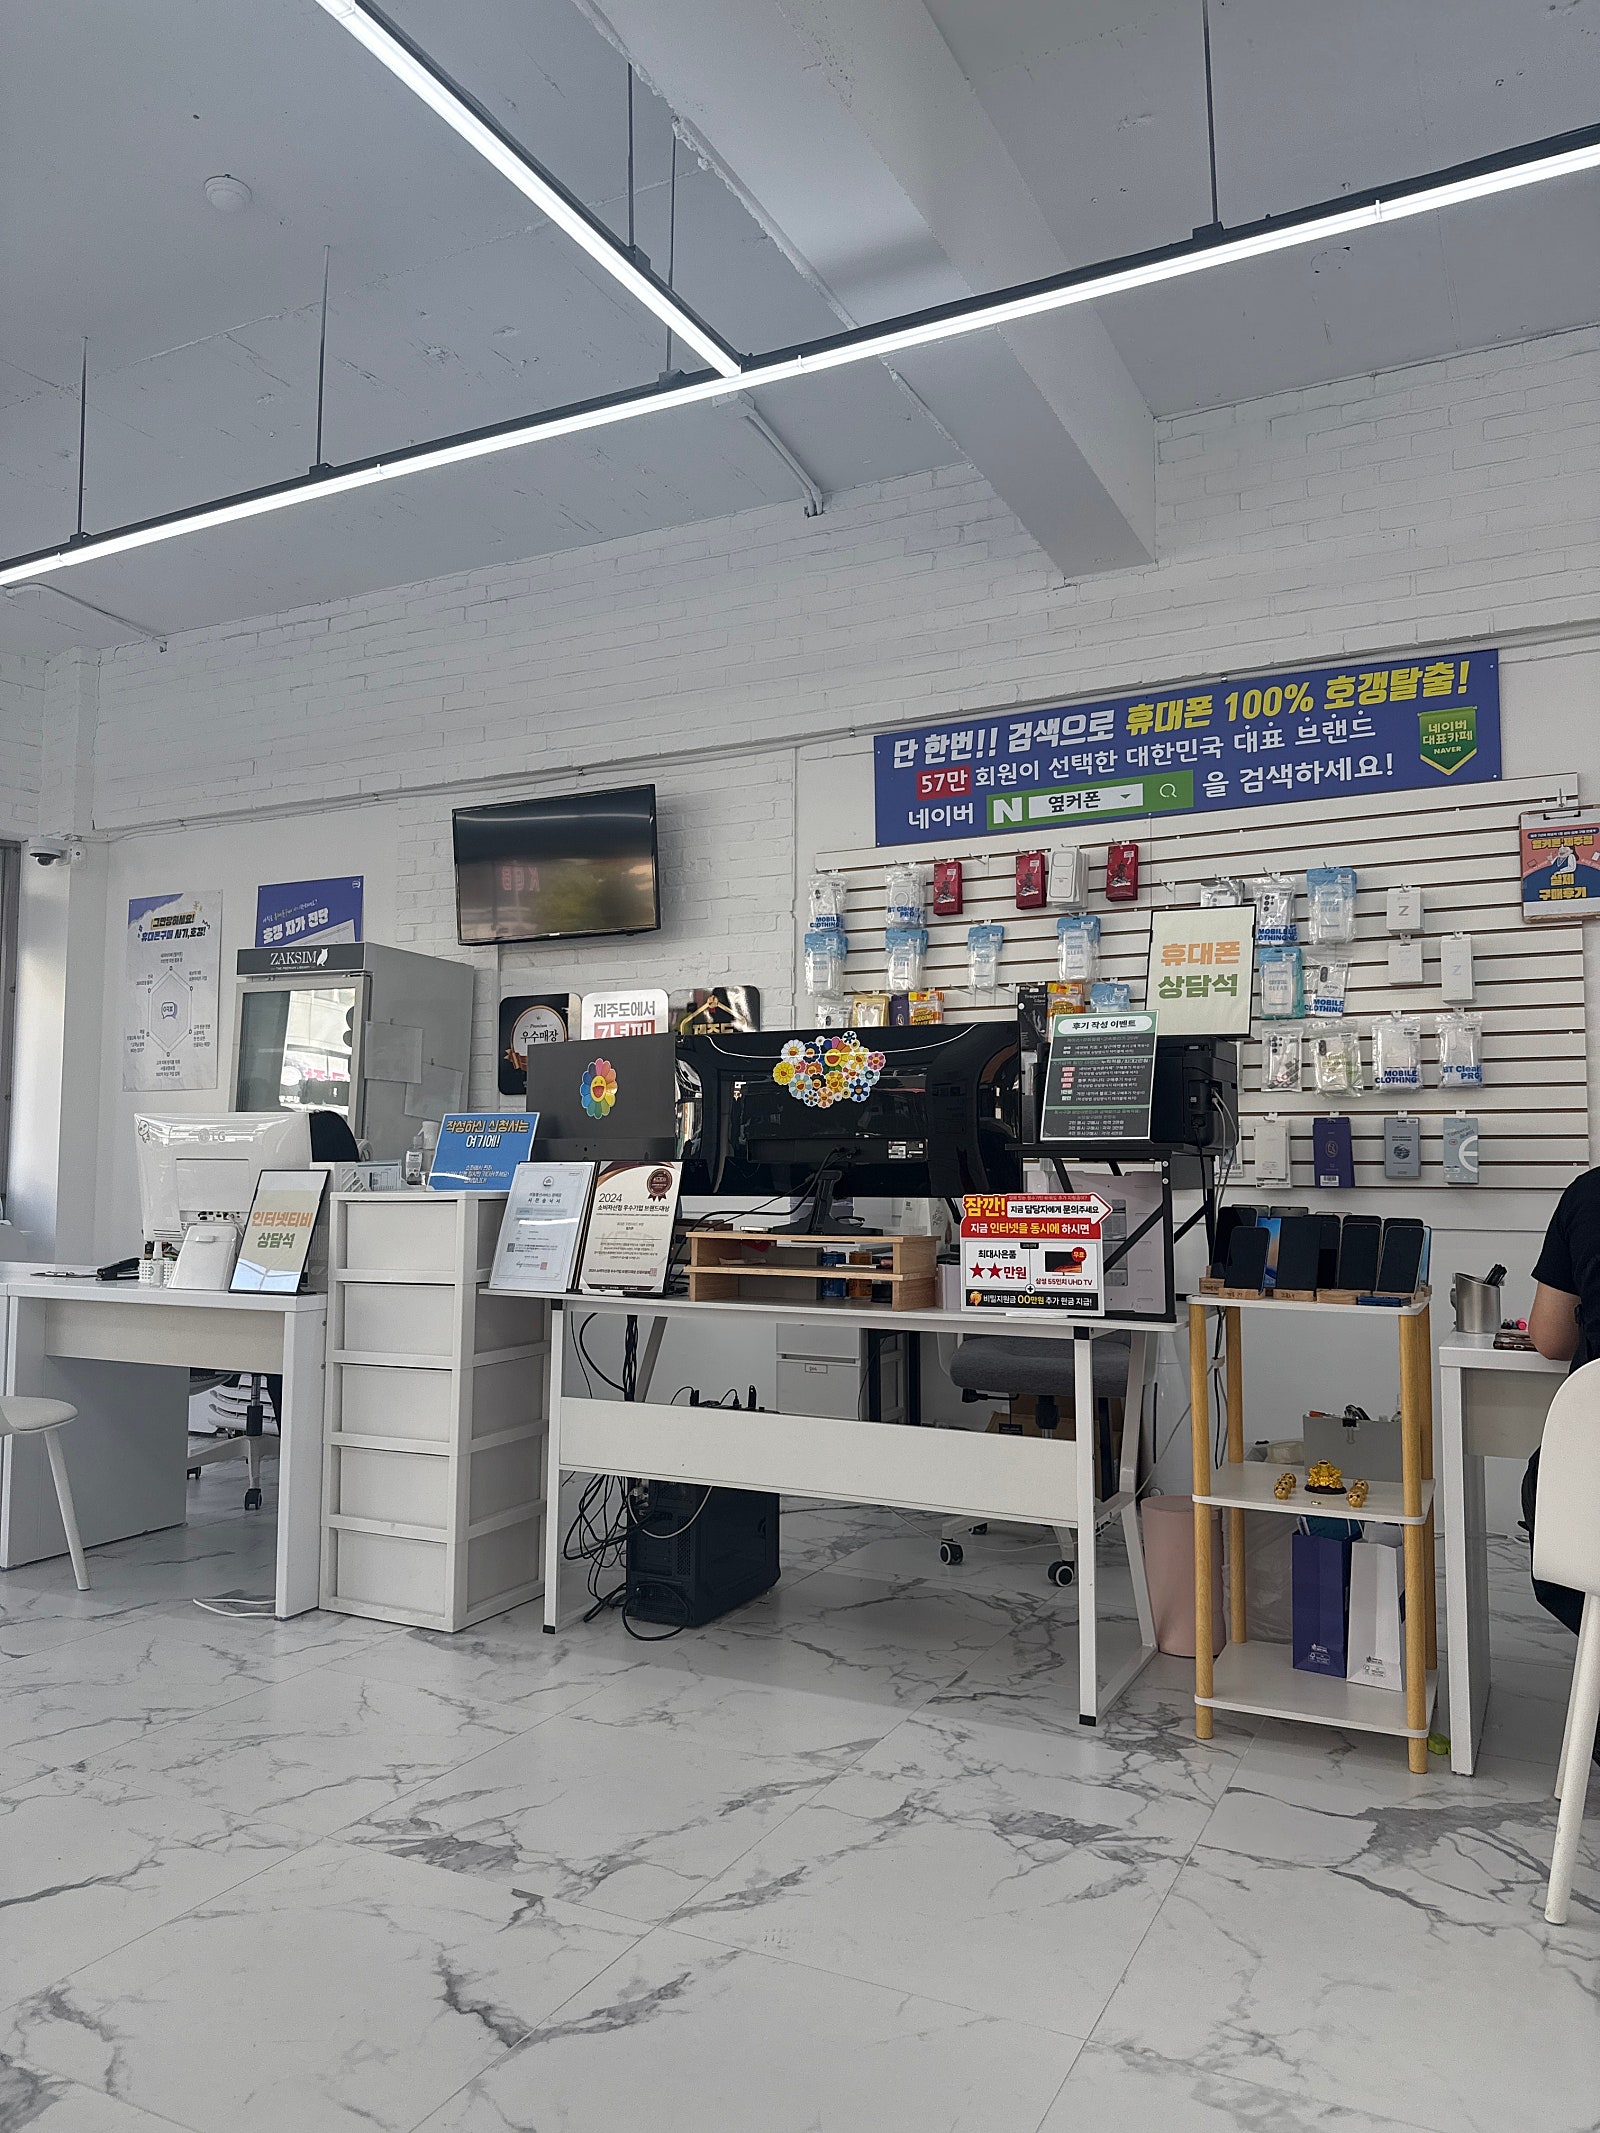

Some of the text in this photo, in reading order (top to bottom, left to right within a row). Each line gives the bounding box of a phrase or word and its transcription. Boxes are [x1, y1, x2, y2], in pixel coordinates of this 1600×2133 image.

[893, 660, 1470, 769] 단 한번!! 검색으로 휴대폰 100% 호갱탈출!
[1428, 719, 1467, 733] 네이버
[1422, 731, 1473, 745] 대표카페
[921, 714, 1376, 794] 57만 회원이 선택한 대한민국 대표 브랜드
[1433, 746, 1462, 755] NAVER
[908, 753, 1394, 830] 네이버 N 옆커폰 을 검색하세요!
[1539, 886, 1587, 900] 구매후기
[285, 916, 306, 936] 자가
[308, 907, 329, 928] 진단
[270, 951, 318, 966] ZAKSIM
[1161, 941, 1241, 967] 휴대폰
[1158, 973, 1238, 1000] 상담석
[593, 1001, 656, 1019] 제주도에서
[1072, 1019, 1136, 1030] 후기 작성 이벤트
[520, 1029, 559, 1044] 우수매장
[446, 1119, 530, 1133] 작성하신 신청서는
[466, 1134, 501, 1148] 여기에!
[599, 1193, 622, 1202] 2024
[965, 1197, 1006, 1217] 잠깐!
[1010, 1204, 1099, 1214] 지금 담당자에게 문의주세요
[252, 1211, 313, 1228] 인터넷티비
[970, 1222, 1090, 1235] 지금 인터넷을 동시에 하시면
[257, 1232, 296, 1248] 상담석
[978, 1249, 1017, 1259] 최대사은품
[1003, 1266, 1027, 1280] 만원
[983, 1294, 1016, 1304] 비밀지원금
[1045, 1297, 1060, 1305] 추가
[1060, 1297, 1075, 1306] 현금
[1076, 1297, 1092, 1307] 지급!
